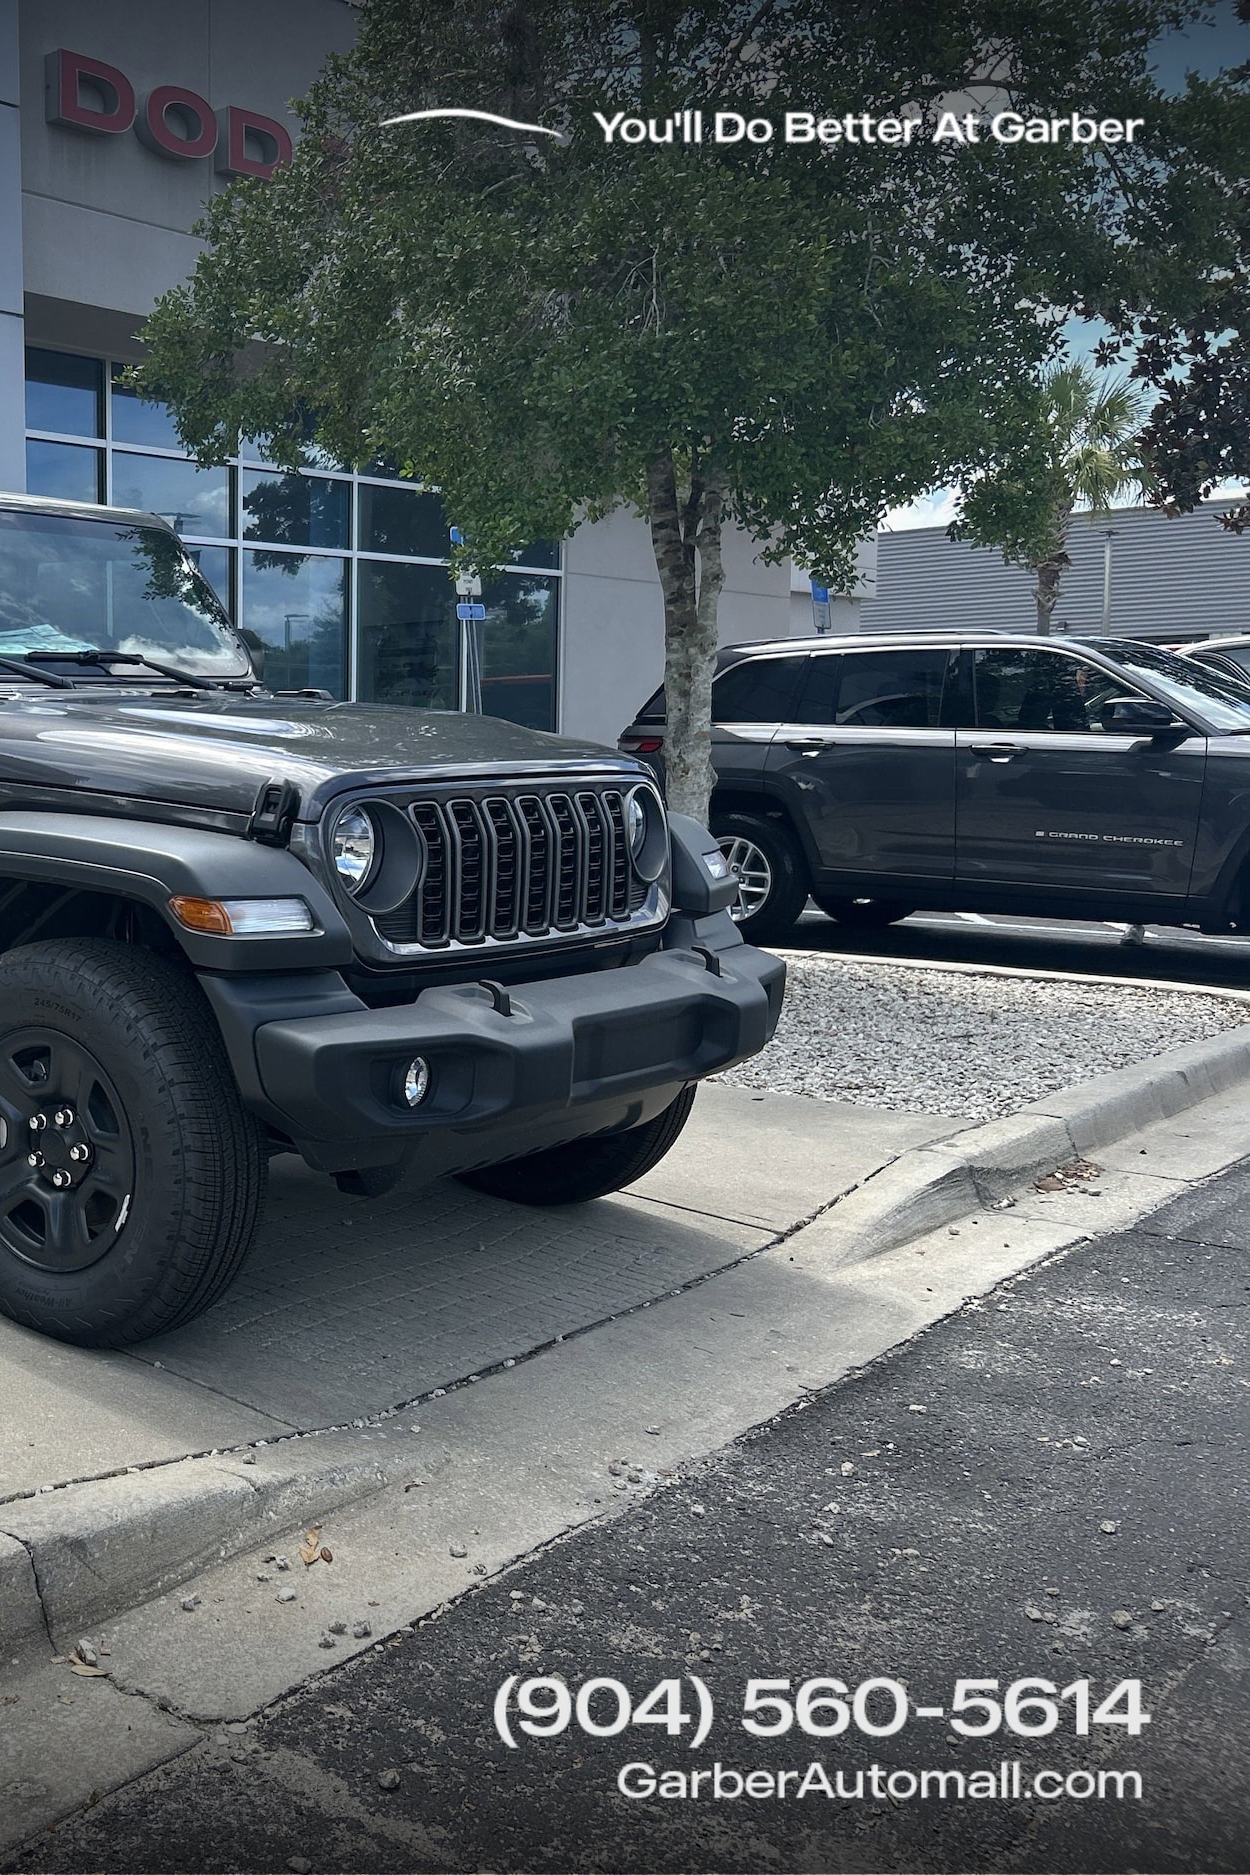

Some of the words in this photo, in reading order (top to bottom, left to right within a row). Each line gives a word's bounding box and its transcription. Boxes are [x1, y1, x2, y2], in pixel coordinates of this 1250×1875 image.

[47, 48, 350, 190] DOD
[1048, 831, 1099, 840] GRAND
[1102, 834, 1184, 847] CHEROKEE
